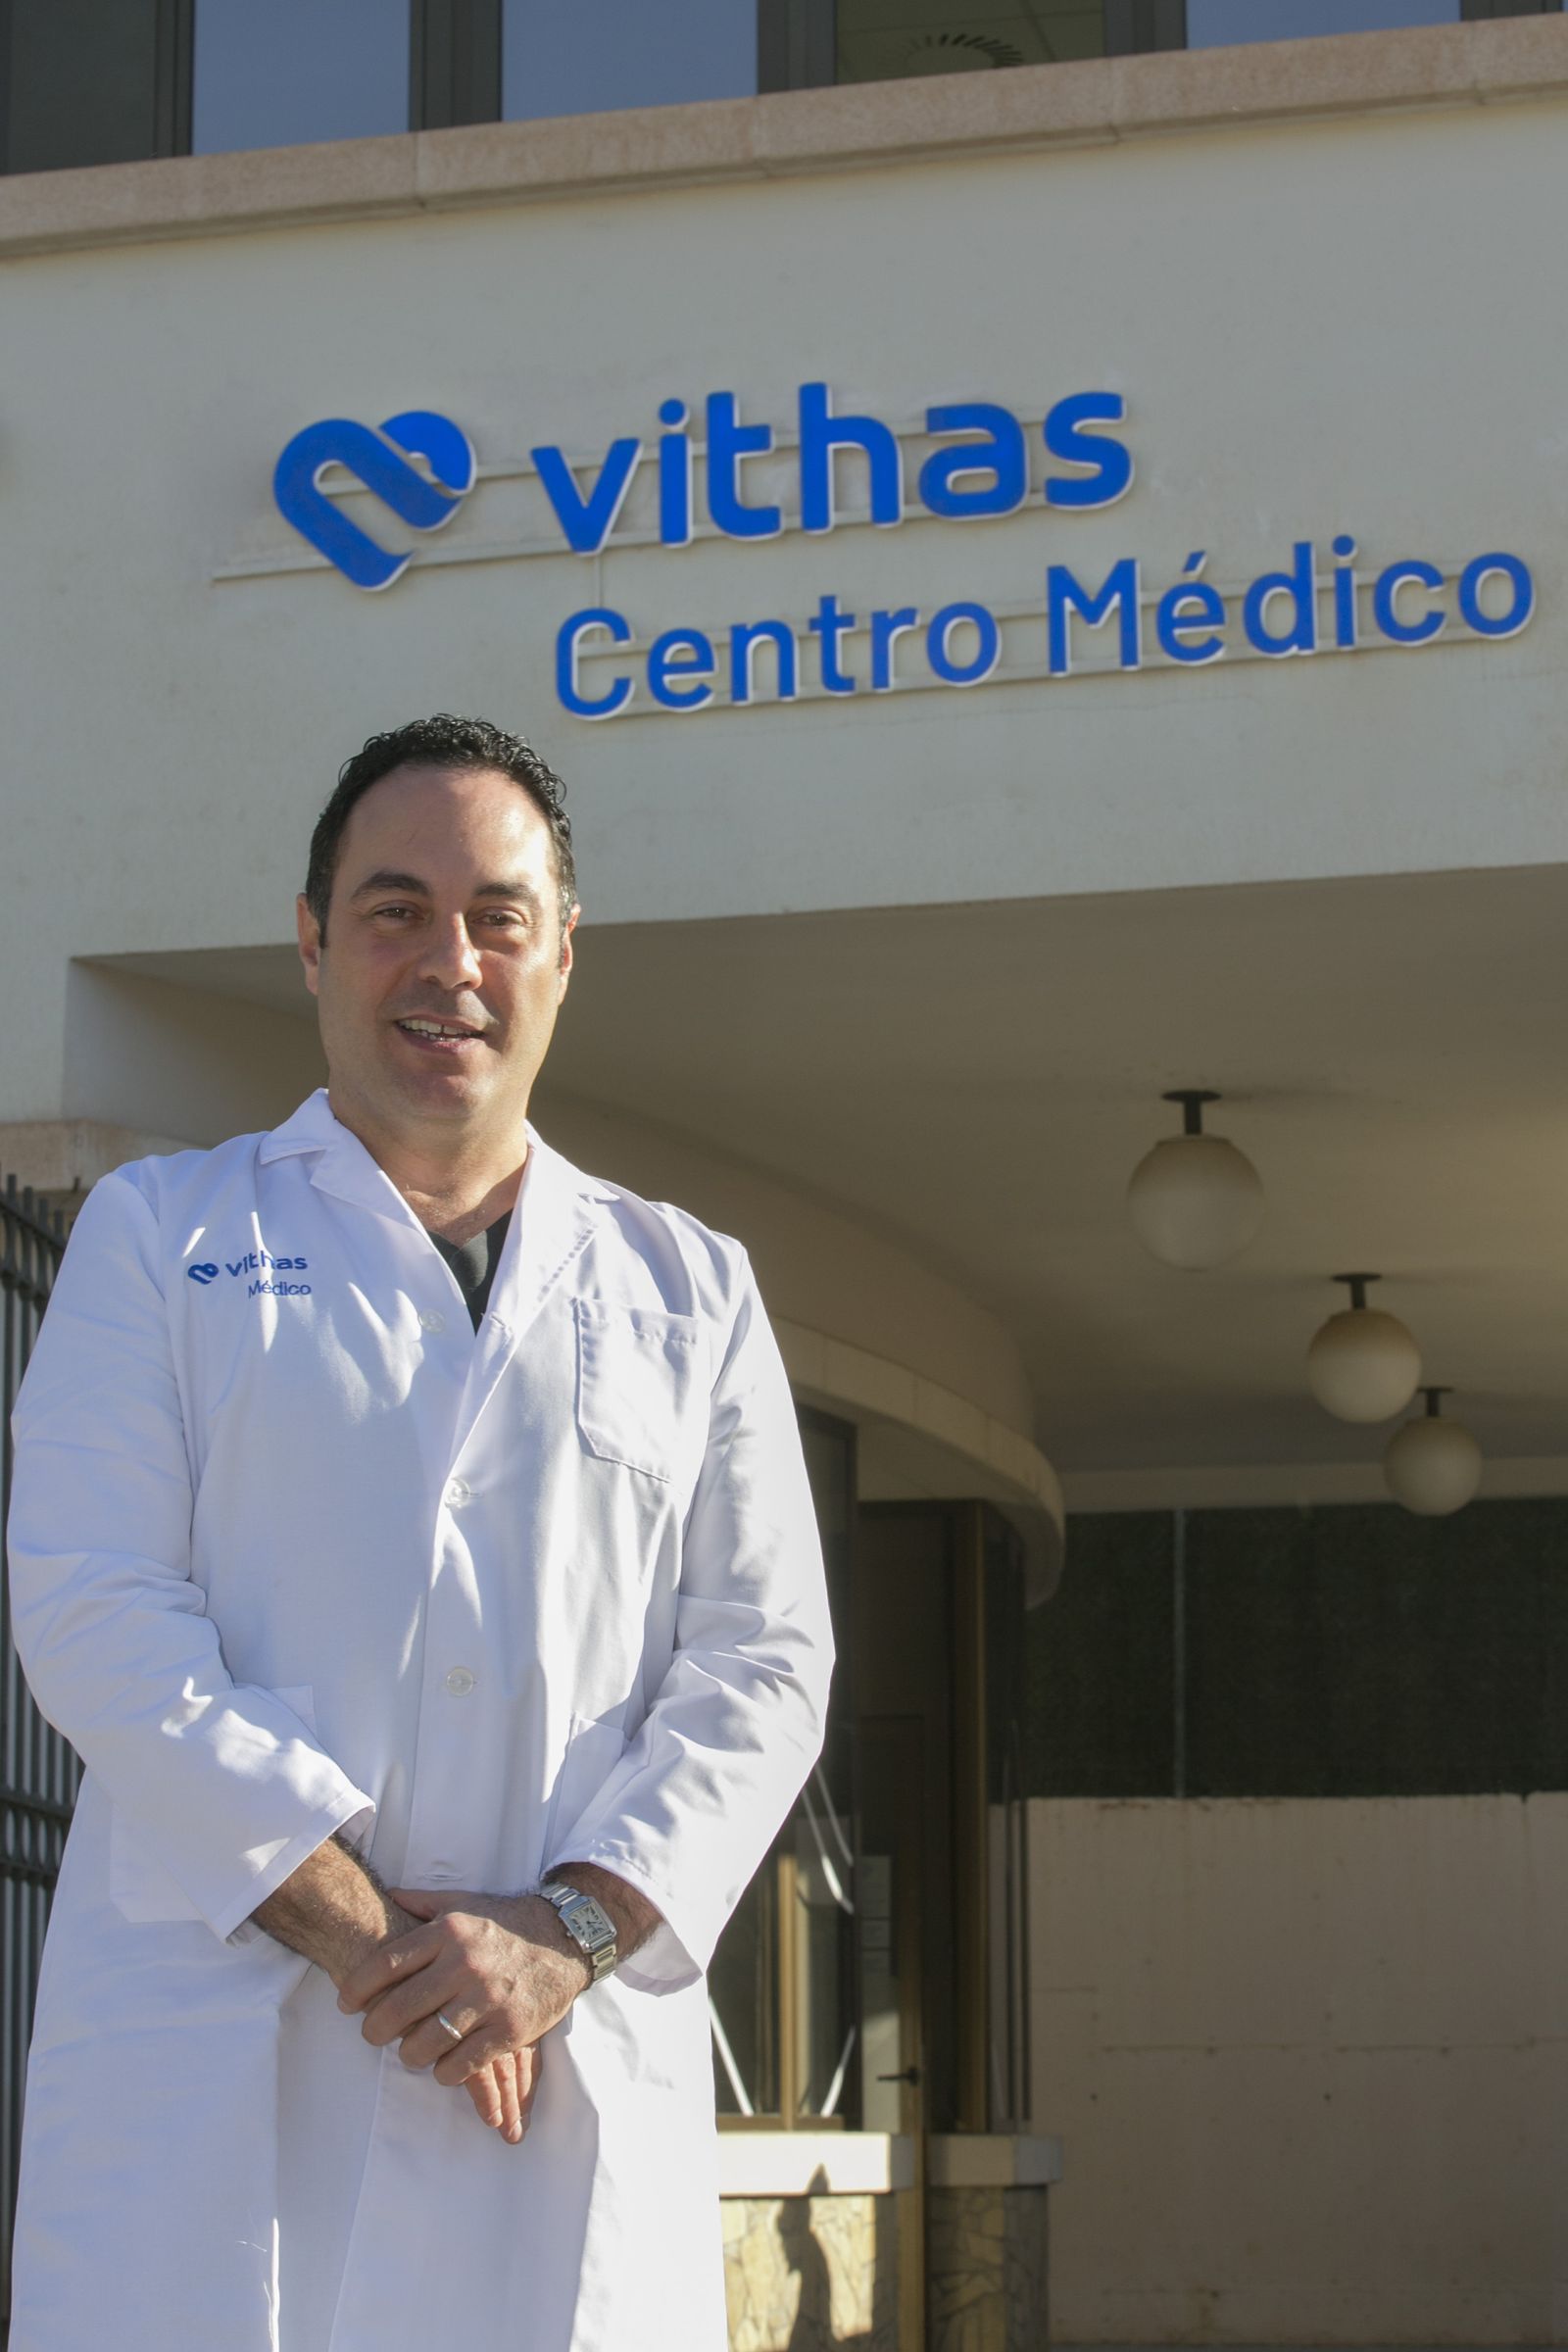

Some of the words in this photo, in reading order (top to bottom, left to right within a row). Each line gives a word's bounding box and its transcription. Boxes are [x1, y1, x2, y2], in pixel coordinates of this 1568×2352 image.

[530, 382, 1134, 555] vithas
[556, 595, 1000, 719] Centro
[1047, 535, 1535, 674] Médico
[224, 1250, 309, 1278] vithas
[247, 1279, 313, 1299] Médico
